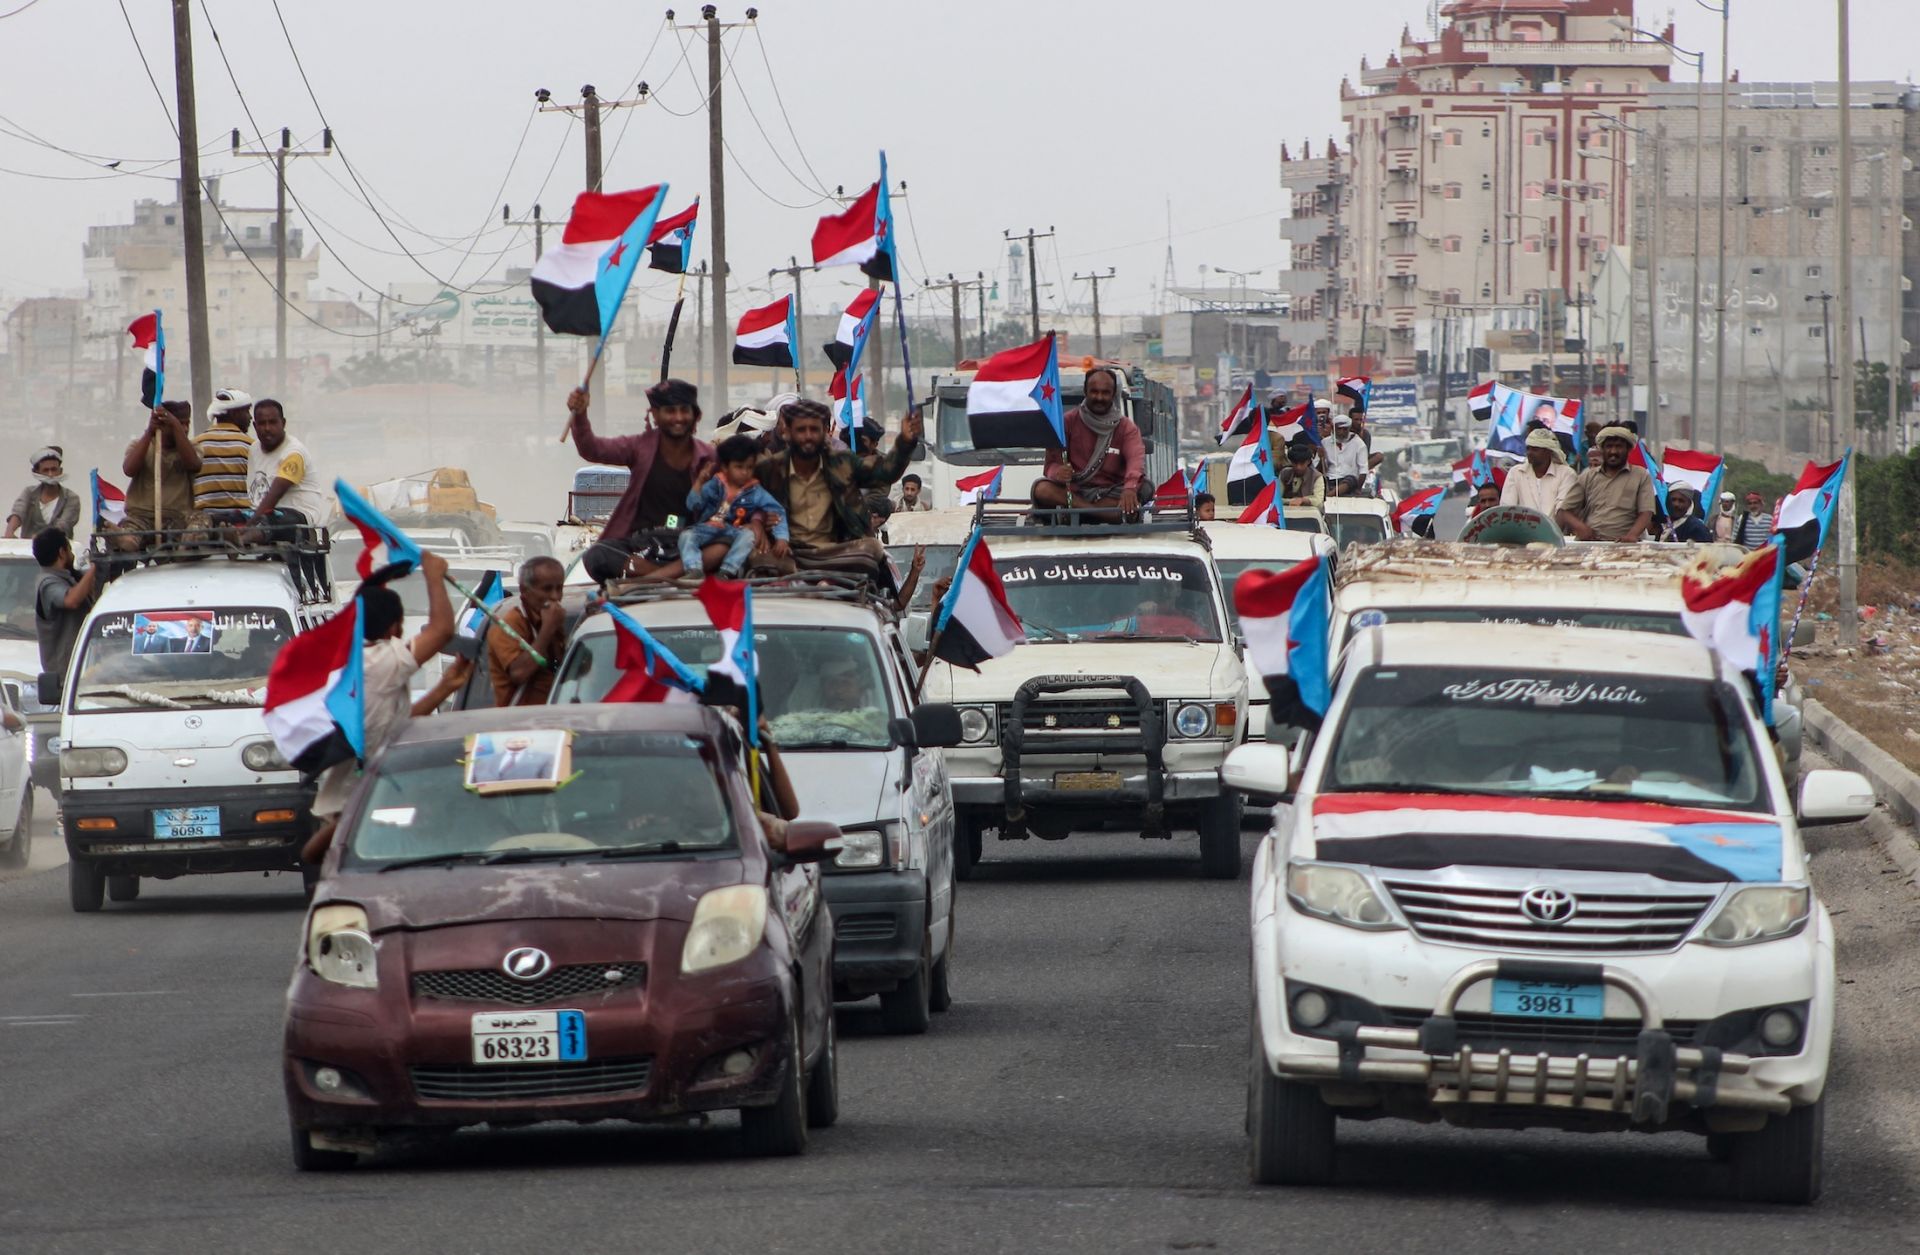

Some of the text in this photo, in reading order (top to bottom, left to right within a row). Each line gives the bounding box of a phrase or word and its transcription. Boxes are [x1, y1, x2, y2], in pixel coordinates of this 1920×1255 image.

[1001, 566, 1037, 584] الله
[1091, 565, 1127, 579] الله
[236, 612, 276, 630] ماشاء
[1517, 994, 1575, 1014] 3981
[483, 1036, 550, 1059] 68323
